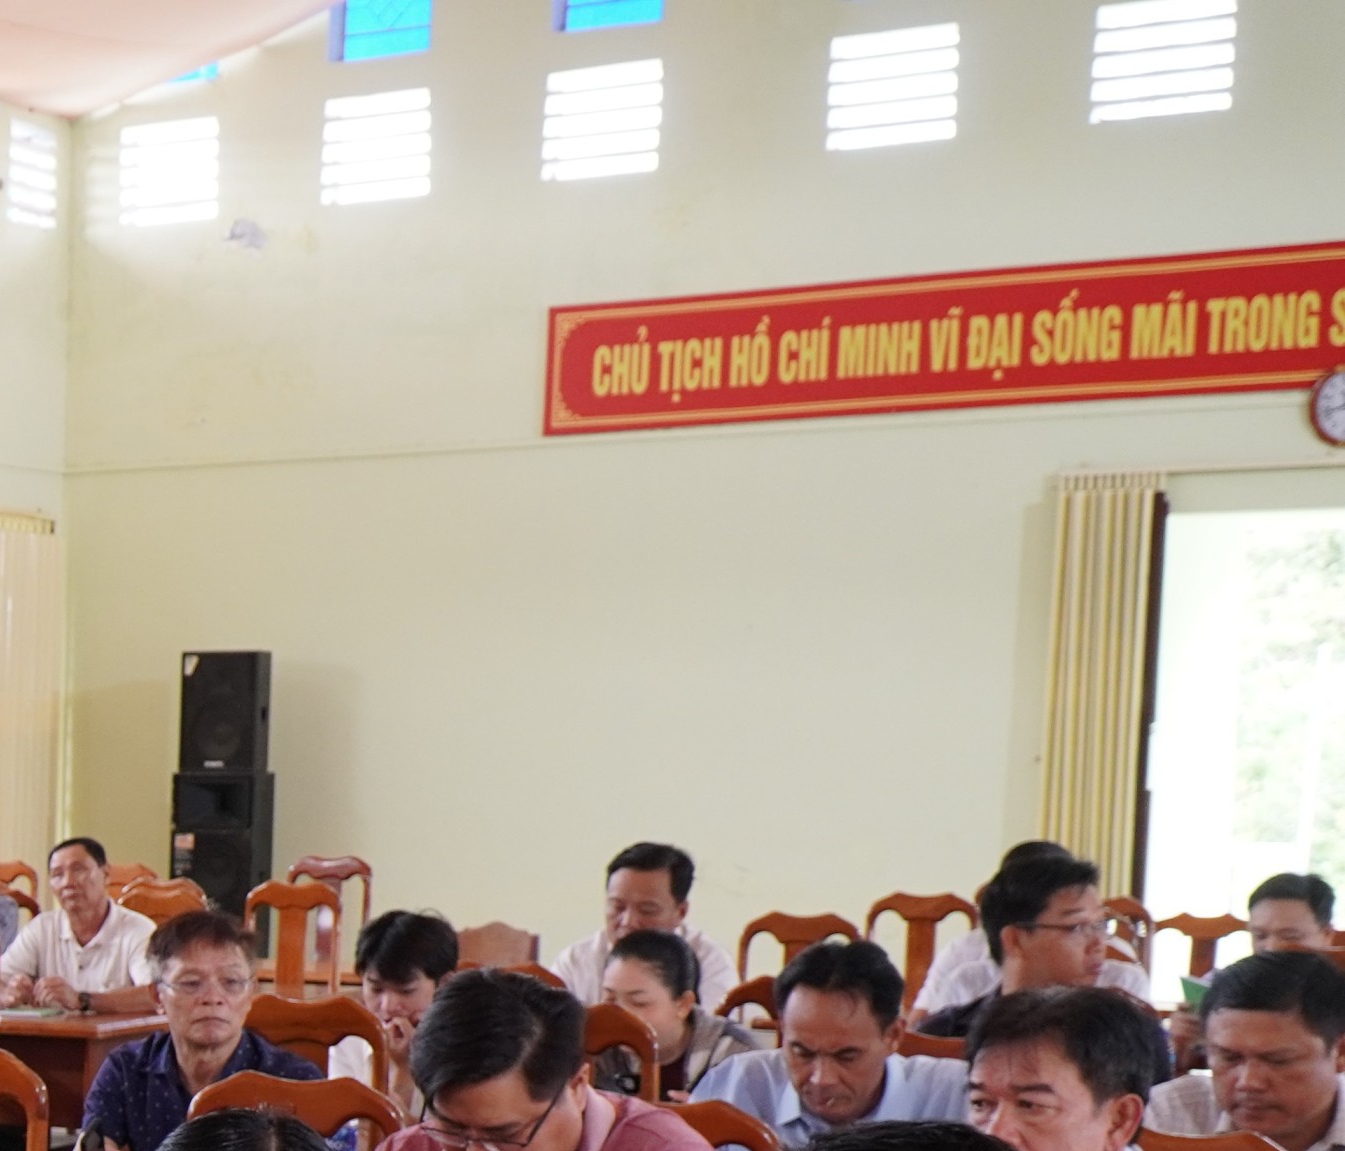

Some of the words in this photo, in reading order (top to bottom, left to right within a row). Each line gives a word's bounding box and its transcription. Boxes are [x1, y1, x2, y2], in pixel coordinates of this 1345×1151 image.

[592, 325, 650, 396] CHỦ
[657, 335, 721, 403] TỊCH
[730, 314, 771, 387] HỒ
[778, 315, 833, 383] CHÍ
[837, 320, 920, 380] MINH
[929, 305, 962, 373] VĨ
[966, 311, 1024, 381] ĐẠI
[1030, 287, 1122, 366] SỐNG
[1129, 291, 1197, 360] MÃI
[1206, 290, 1320, 355] TRONG
